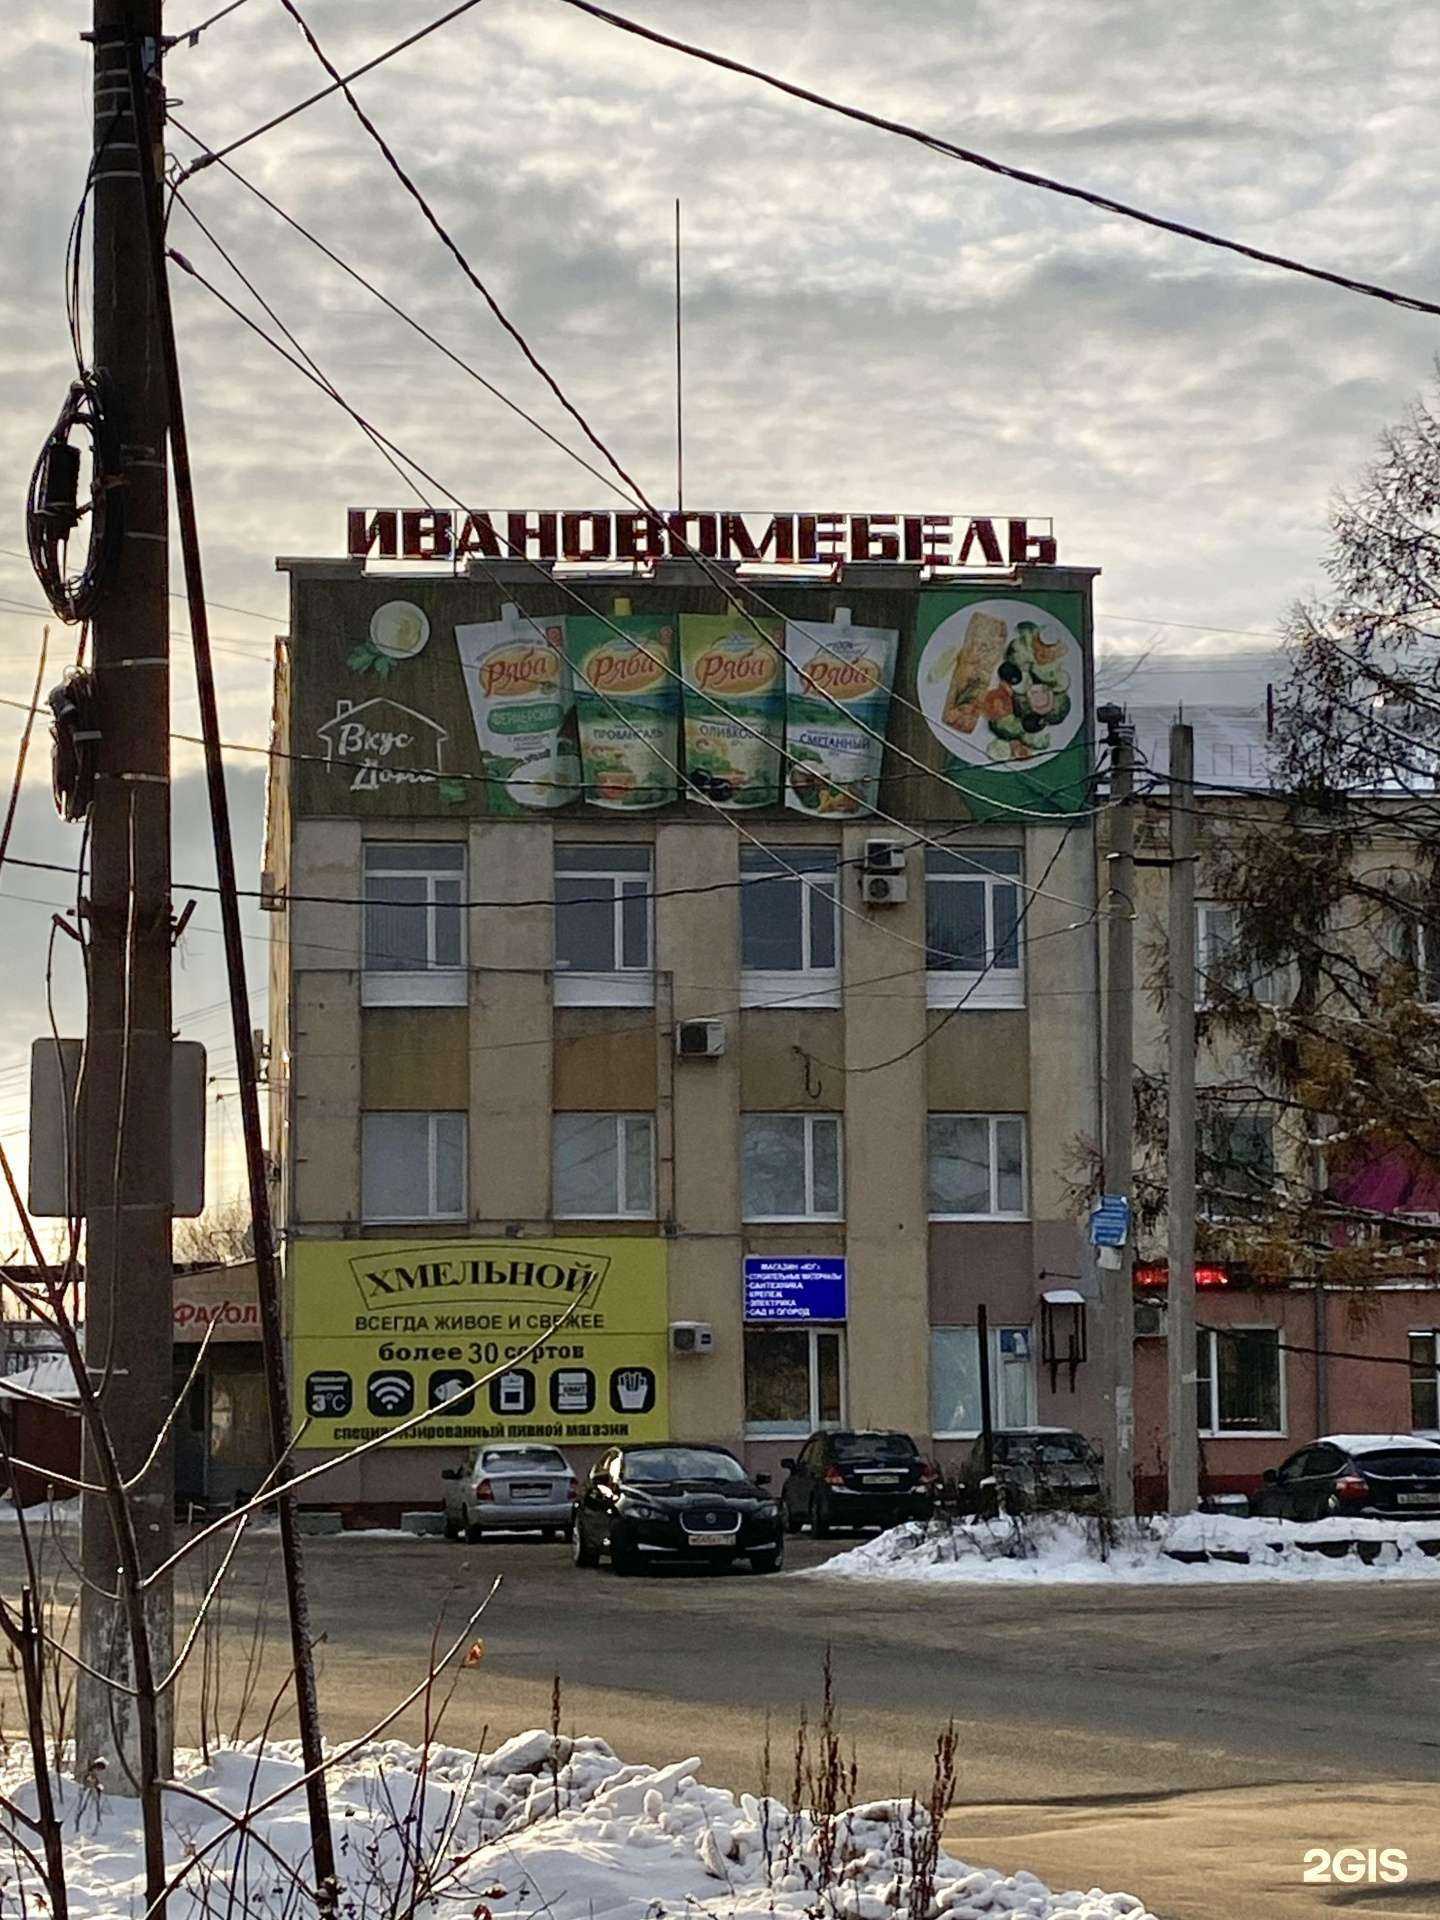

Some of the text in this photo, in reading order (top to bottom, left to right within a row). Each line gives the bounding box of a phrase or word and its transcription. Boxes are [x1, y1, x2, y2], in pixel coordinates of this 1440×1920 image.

[348, 509, 1056, 565] ИВАНОВОМЕБЕЛЬ
[486, 647, 546, 697] Ряба
[592, 643, 655, 687] Ряба
[699, 649, 765, 690] Ряба
[800, 657, 868, 695] Ряба
[338, 723, 414, 755] Вкус
[364, 1259, 599, 1297] ХМЕЛЬНОЙ
[356, 1313, 604, 1332] ВСЕГДА ЖИВОЕ И СВЕЖЕЕ
[379, 1342, 584, 1364] более 30 сортов
[508, 1420, 563, 1439] пивной
[567, 1422, 629, 1437] магазин
